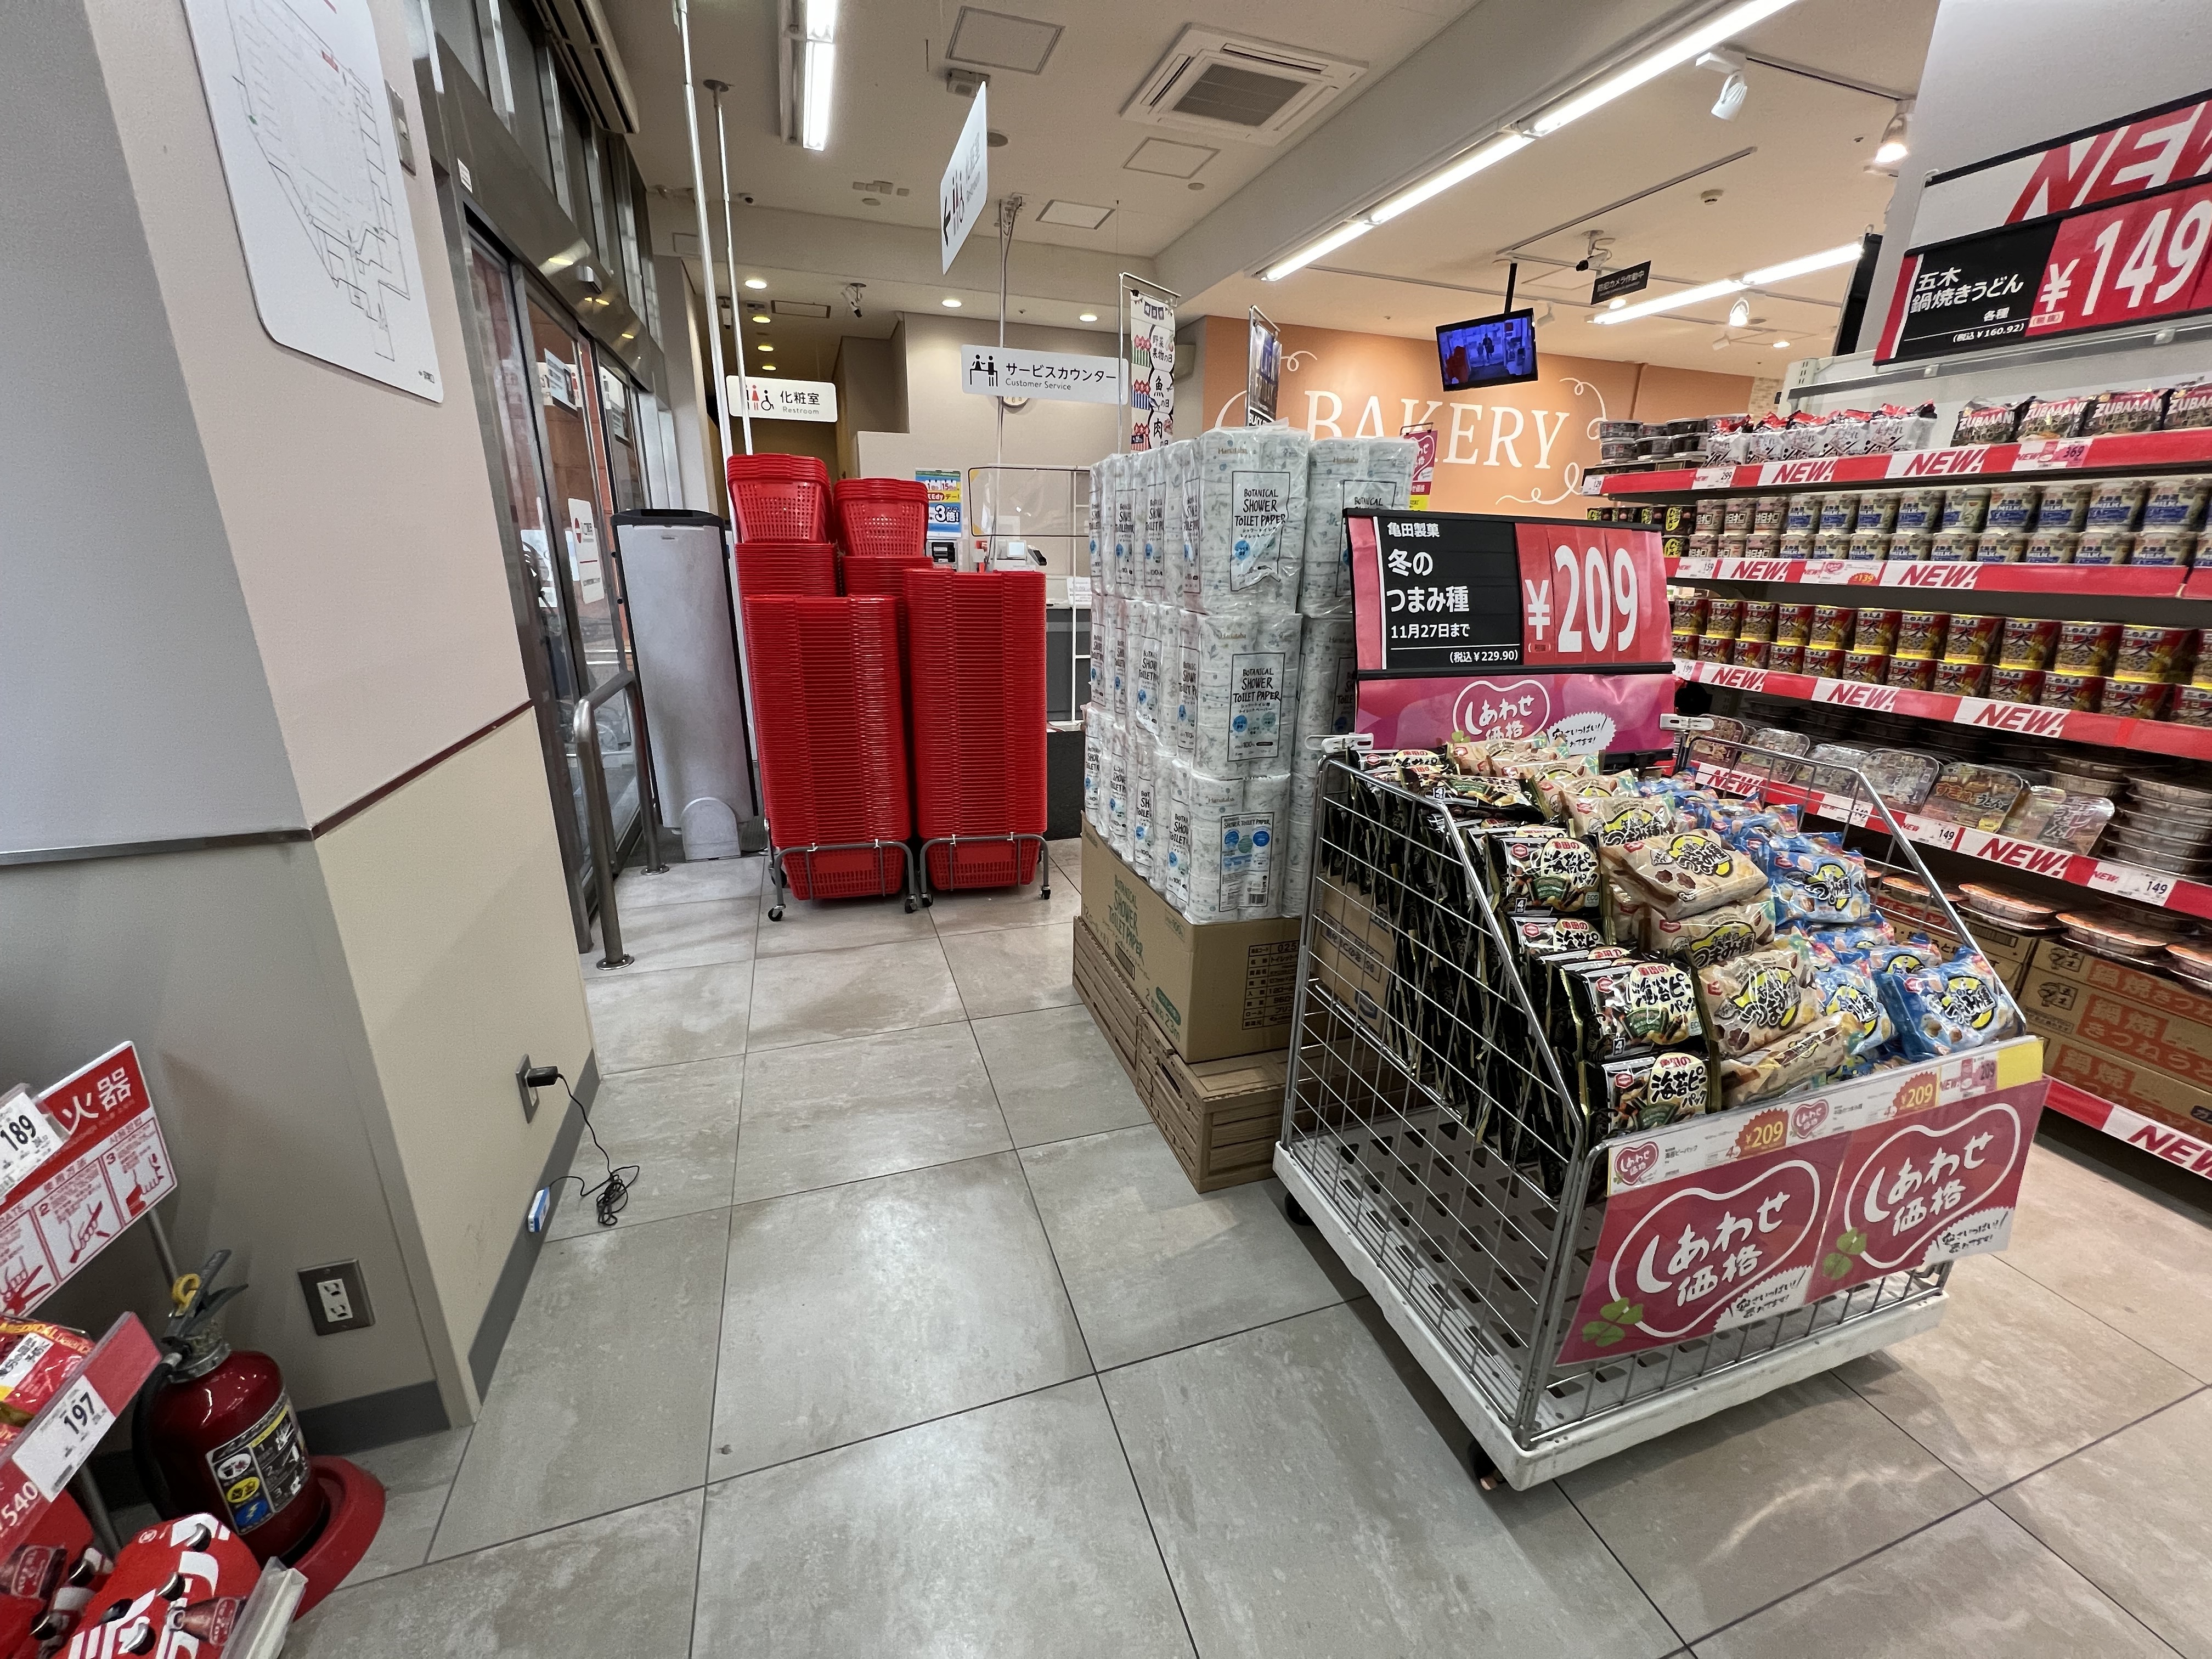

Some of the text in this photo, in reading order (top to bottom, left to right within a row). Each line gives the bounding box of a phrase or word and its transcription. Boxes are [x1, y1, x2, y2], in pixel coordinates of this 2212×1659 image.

[1916, 267, 1961, 292] 五木
[1910, 274, 2024, 313] 鍋焼きうどん
[1006, 363, 1116, 382] サービスカウンター
[1005, 378, 1071, 391] Customer Service
[1154, 376, 1164, 398] 魚
[780, 391, 820, 405] 化粧室
[782, 406, 820, 415] Restroom
[1153, 418, 1163, 439] 肉
[1304, 390, 1570, 469] BAKERY
[2063, 444, 2084, 458] 369
[1772, 456, 1838, 483] NEW!
[1903, 449, 1987, 476] NEW!
[1721, 471, 1733, 481] 299
[1244, 488, 1279, 498] BOTANICAL
[935, 504, 946, 522] 3
[1243, 498, 1277, 513] SHOWER
[1234, 513, 1287, 527] TOILET PAPER
[1387, 522, 1440, 538] 亀田製菓
[1388, 549, 1434, 577] 冬の
[1703, 563, 1714, 571] 159
[1731, 561, 1790, 580] NEW!
[1897, 565, 1977, 588] NEW!
[1386, 586, 1469, 613] つまみ種
[1391, 623, 1470, 639] 11月27日まで
[1243, 668, 1274, 676] BOTANICAL
[1683, 665, 1692, 674] 199
[1711, 667, 1766, 690] NEW!
[1242, 677, 1273, 690] SHOWER
[1233, 690, 1281, 703] TOILET PAPER
[1827, 684, 1897, 709] NEW!
[1465, 695, 1534, 735] しあわせ
[1973, 704, 2064, 735] NEW!
[1486, 720, 1524, 741] 価格
[1939, 828, 1954, 840] 149
[1553, 840, 1580, 850] 亀田の
[1977, 838, 2070, 876] NEW!
[2146, 881, 2168, 894] 149
[1108, 905, 1125, 940] TOILET
[1114, 890, 1139, 936] SHOWER
[1562, 920, 1588, 930] 亀田の
[1693, 935, 1753, 968] つまみ種
[1638, 964, 1669, 975] 亀田の
[1660, 1057, 1691, 1068] 亀田の
[1651, 1065, 1707, 1103] 海苔ピー
[61, 1066, 131, 1136] 火器
[1682, 1090, 1706, 1108] パック
[1901, 1084, 1933, 1108] ¥209
[1796, 1107, 1822, 1127] しあわせ
[1, 1115, 36, 1151] 189
[1746, 1121, 1784, 1148] ¥209
[106, 1153, 116, 1165] 3
[1620, 1150, 1650, 1172] しあわせ
[1864, 1131, 1995, 1223] しあわせ
[40, 1203, 49, 1216] 2
[1893, 1179, 1967, 1237] 価格
[1636, 1190, 1791, 1294] しあわせ
[1676, 1243, 1763, 1307] 価格
[64, 1391, 95, 1434] 197
